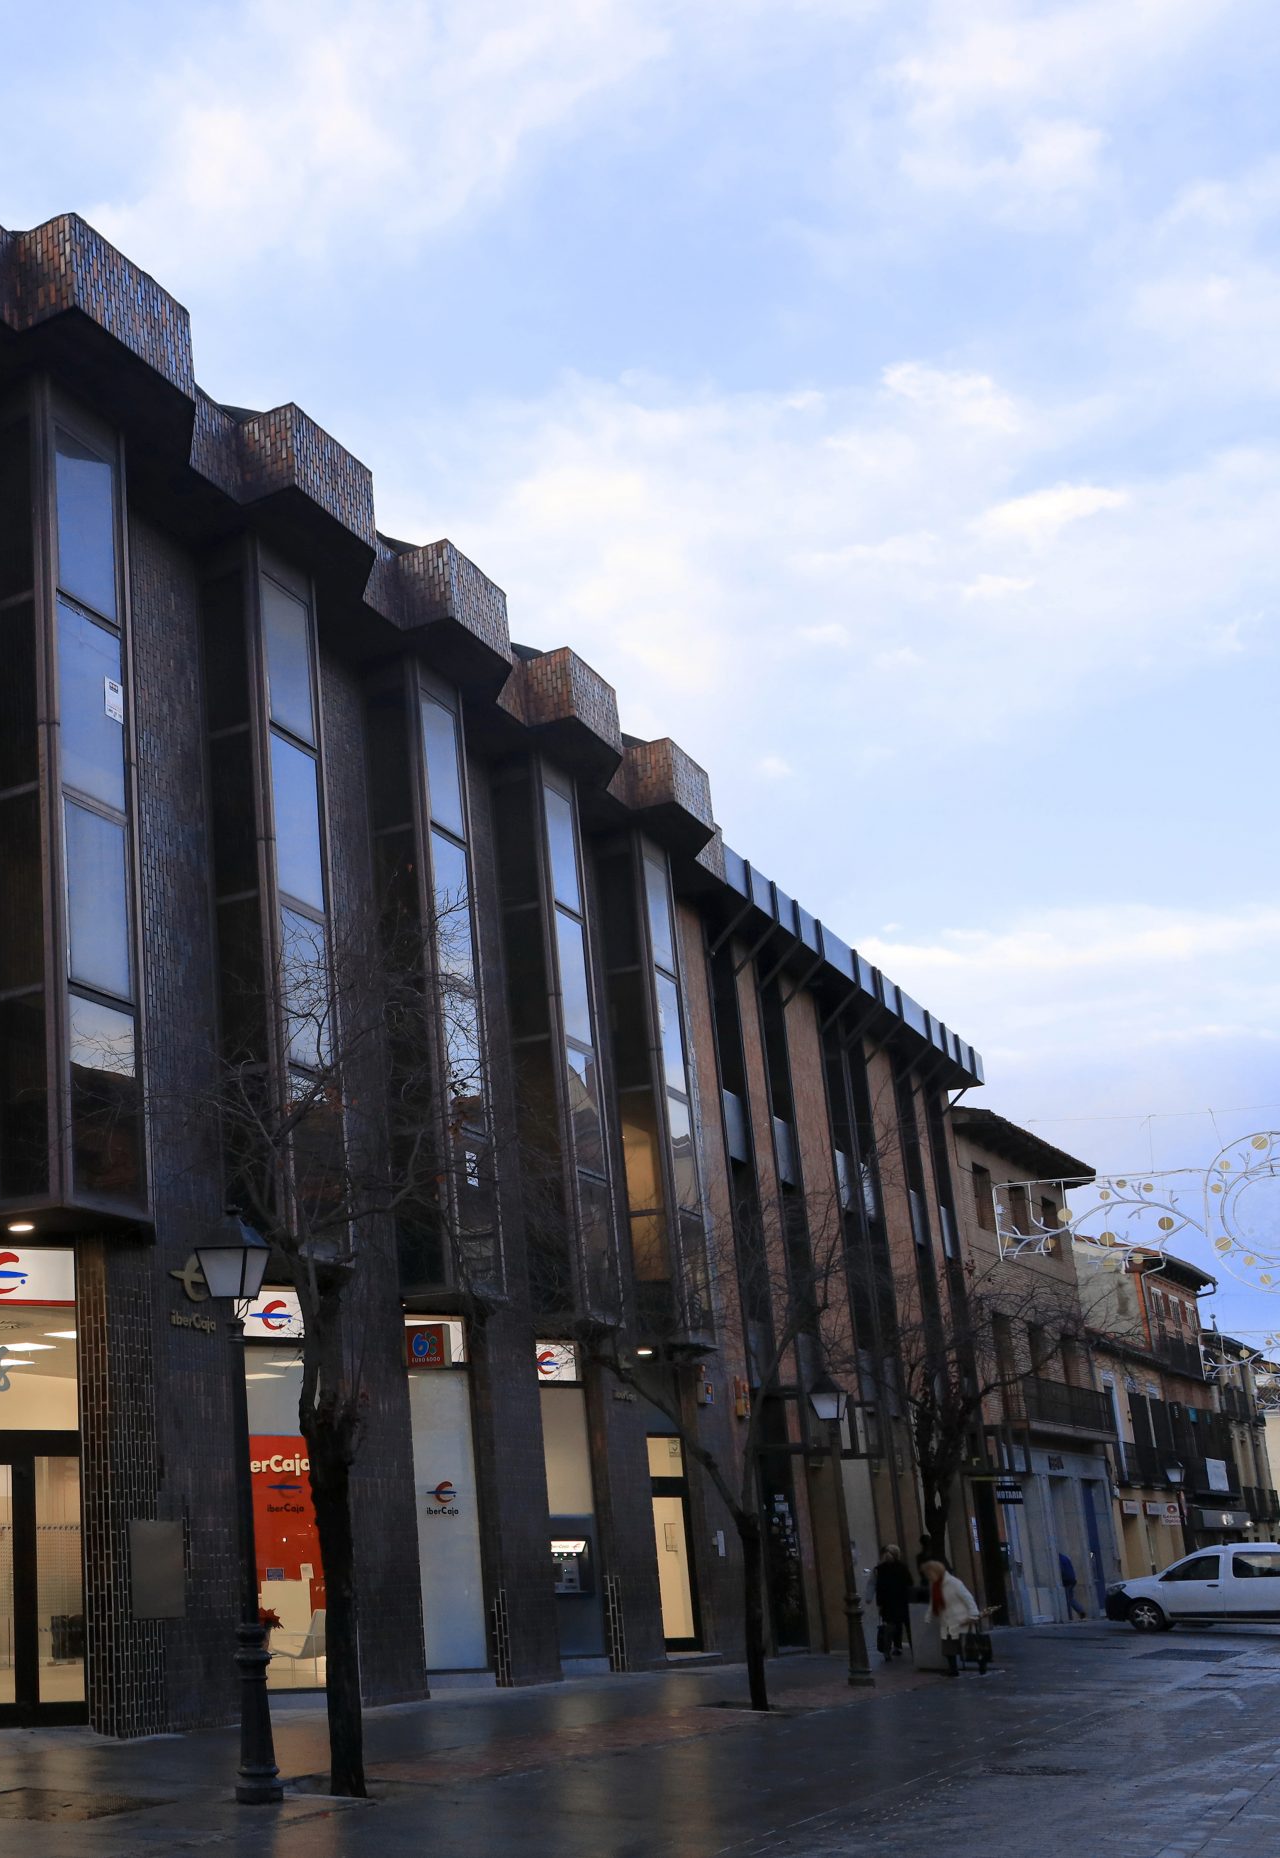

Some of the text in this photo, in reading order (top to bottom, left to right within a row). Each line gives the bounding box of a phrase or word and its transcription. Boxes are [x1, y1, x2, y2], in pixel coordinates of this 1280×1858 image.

[169, 1310, 217, 1333] iberCaja
[250, 1453, 310, 1476] erCaja
[267, 1503, 305, 1514] iberCaja
[426, 1506, 459, 1517] iberCaja
